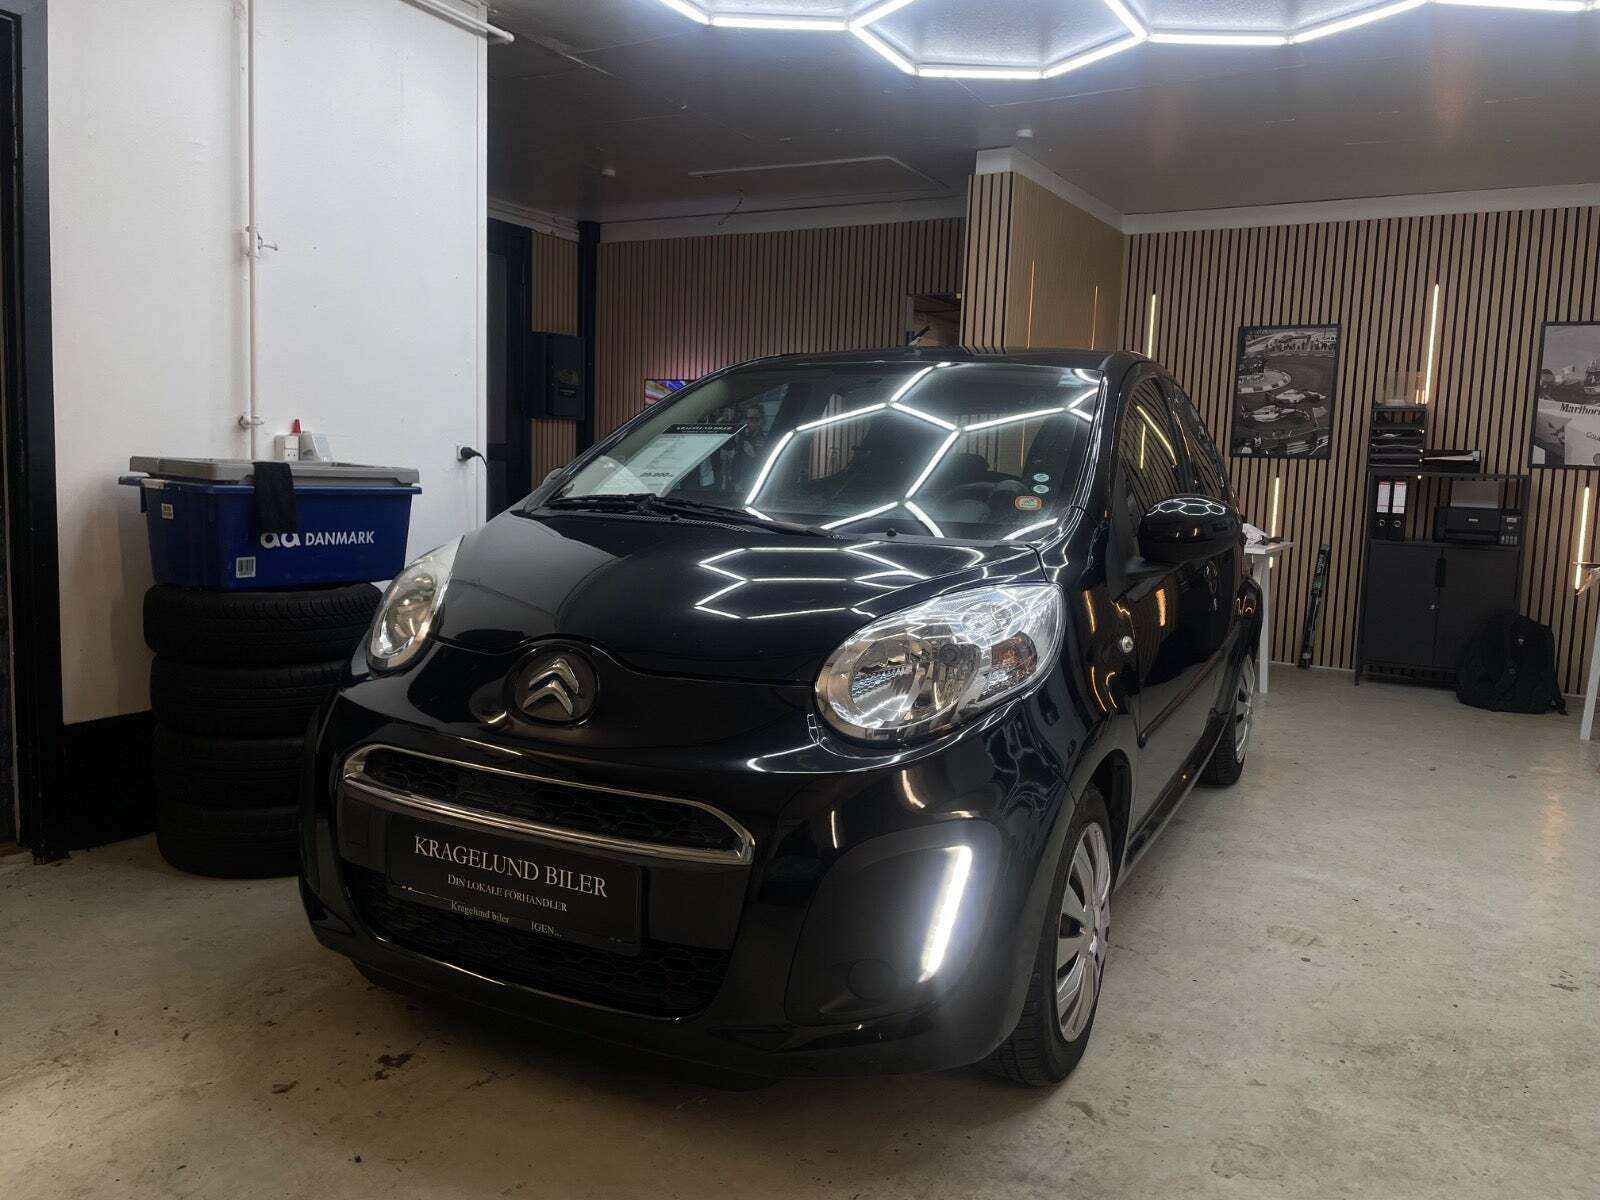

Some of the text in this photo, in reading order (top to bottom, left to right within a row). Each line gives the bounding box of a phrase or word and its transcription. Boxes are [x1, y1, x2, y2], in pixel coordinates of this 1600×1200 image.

[1560, 403, 1600, 416] Marlbor
[305, 530, 375, 546] DANMARK
[414, 835, 608, 898] KRAGELUND BILER
[447, 873, 568, 913] DIN LOKALE FORHANDLER
